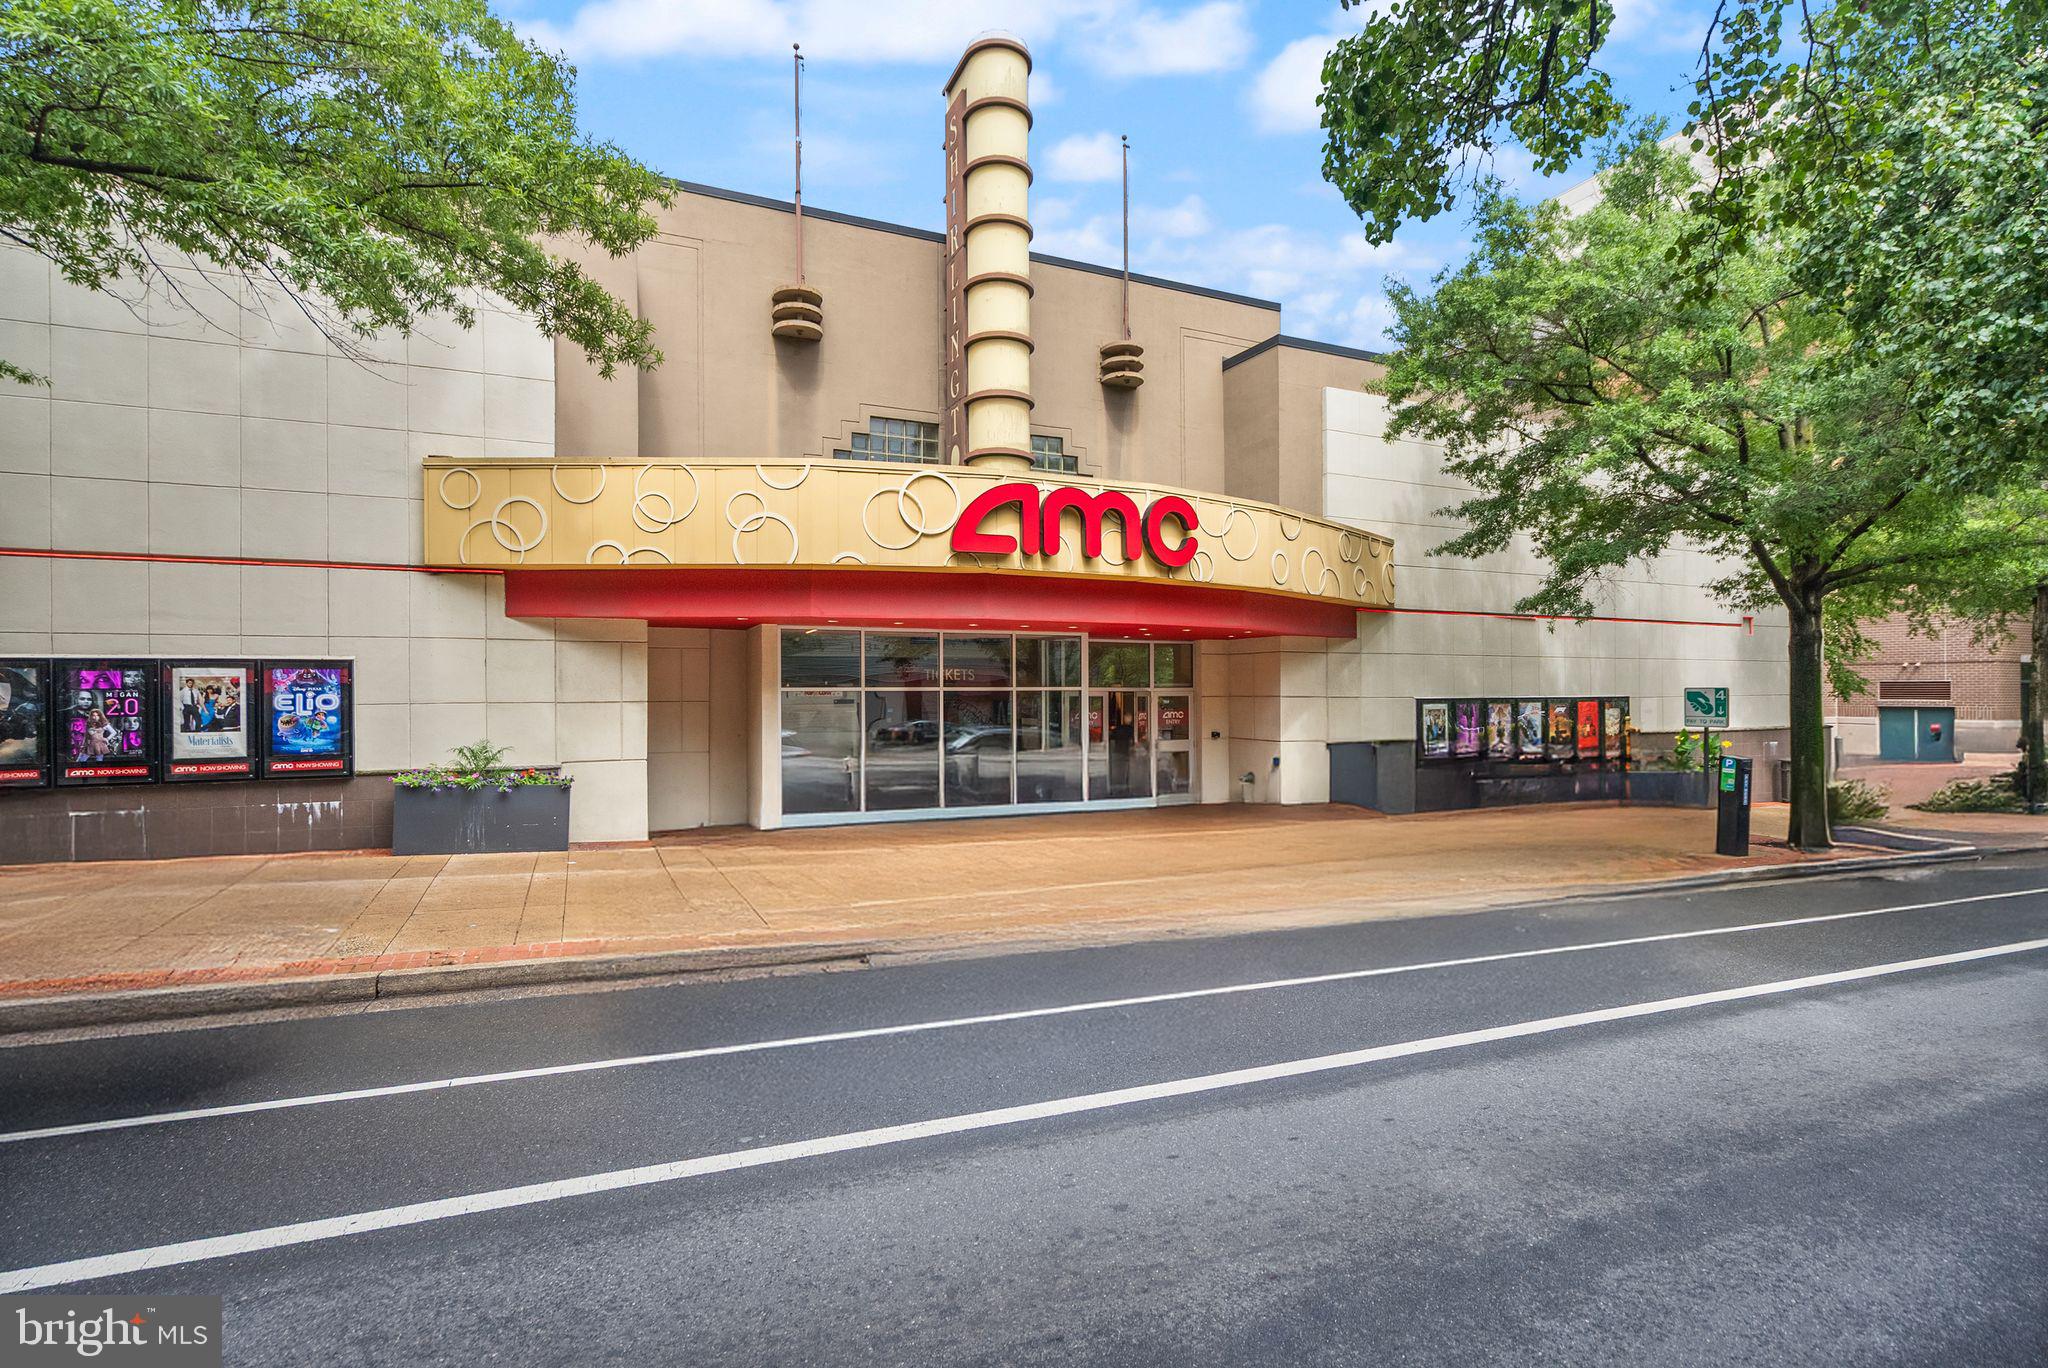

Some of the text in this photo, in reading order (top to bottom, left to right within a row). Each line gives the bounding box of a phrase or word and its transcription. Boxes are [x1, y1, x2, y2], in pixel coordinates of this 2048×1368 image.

[924, 668, 976, 681] TIKETS
[1715, 690, 1727, 701] 4
[106, 698, 138, 715] 2.0
[187, 735, 234, 746] Materialists
[1725, 759, 1733, 767] P
